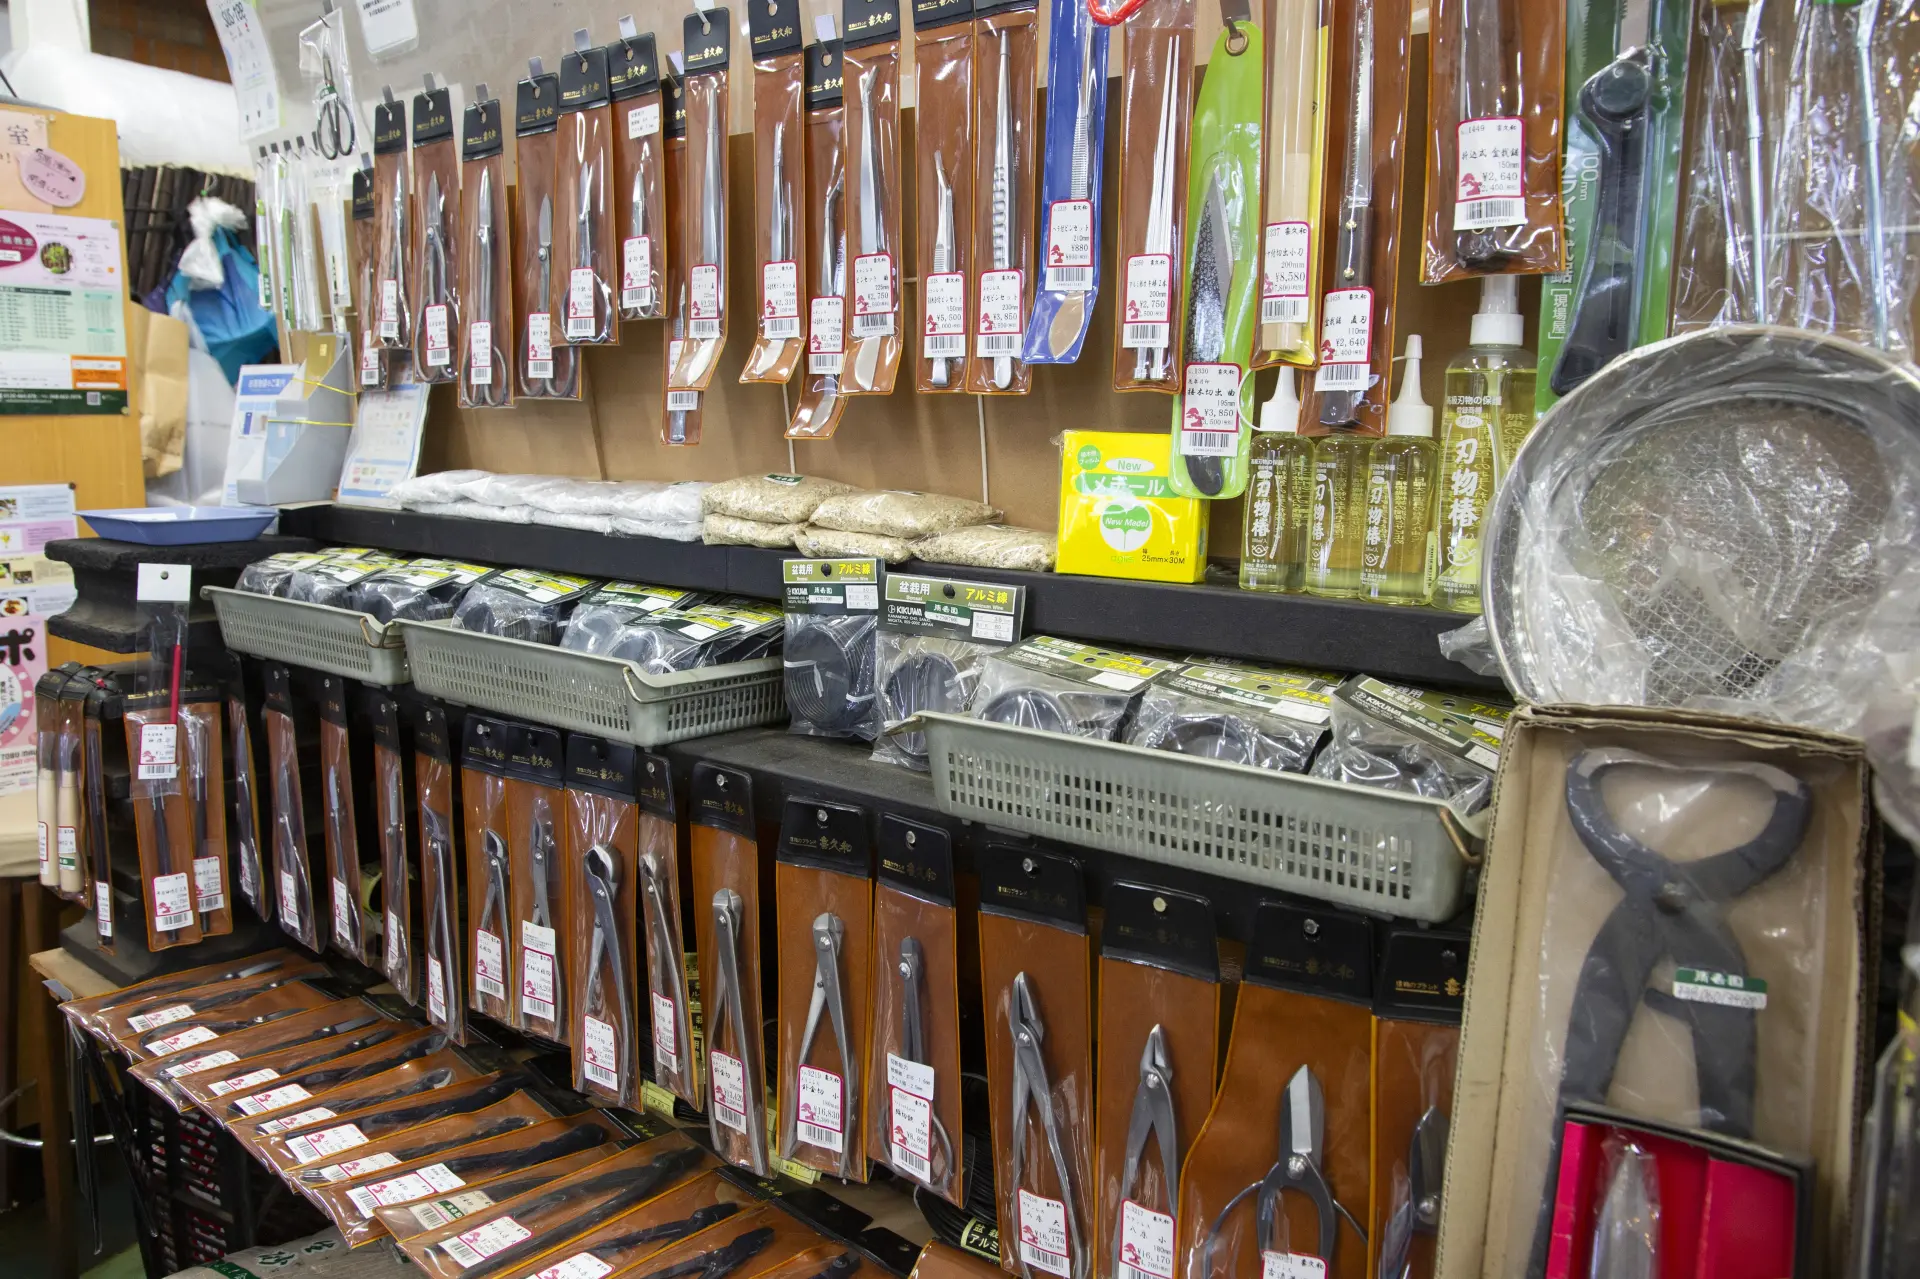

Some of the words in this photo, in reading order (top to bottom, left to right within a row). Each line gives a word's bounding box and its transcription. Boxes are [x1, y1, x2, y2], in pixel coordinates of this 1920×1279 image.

[868, 12, 892, 26] 喜久和
[772, 26, 792, 39] 喜久和
[704, 46, 723, 58] 喜久和
[627, 64, 647, 78] 喜久和
[582, 82, 599, 96] 喜久和
[1483, 172, 1518, 181] ¥2,640
[1580, 152, 1599, 200] 100mm
[1276, 272, 1305, 282] ¥8,580
[1336, 338, 1365, 347] ¥2,640
[1118, 460, 1141, 470] New
[1095, 476, 1164, 496] メデール
[1449, 438, 1479, 527] 刃物椿
[1251, 481, 1271, 537] 刃物椿
[1312, 484, 1326, 541] 刃物椿
[1366, 487, 1383, 545] 刃物椿
[792, 564, 813, 575] 盆栽用
[838, 563, 870, 575] アルミ線
[899, 581, 930, 595] 盆栽用
[966, 588, 1008, 604] アルミ線
[896, 606, 922, 616] KIKUWA
[1366, 697, 1402, 716] KIKUWA
[485, 747, 504, 761] 喜久和
[531, 754, 552, 768] 喜久和
[600, 768, 623, 782] 喜久和
[724, 800, 745, 816] 喜久和
[819, 835, 852, 853] 喜久和
[906, 862, 936, 881] 喜久和
[1306, 957, 1354, 979] 喜久和
[730, 1059, 741, 1068] 喜久和
[825, 1074, 840, 1083] 喜久和
[802, 1084, 824, 1095] 針金切
[814, 1105, 839, 1120] ¥16,830
[1153, 1216, 1169, 1224] 喜久和
[1035, 1230, 1064, 1244] ¥16,170
[1137, 1248, 1170, 1264] ¥16,170
[1301, 1259, 1324, 1269] 喜久和
